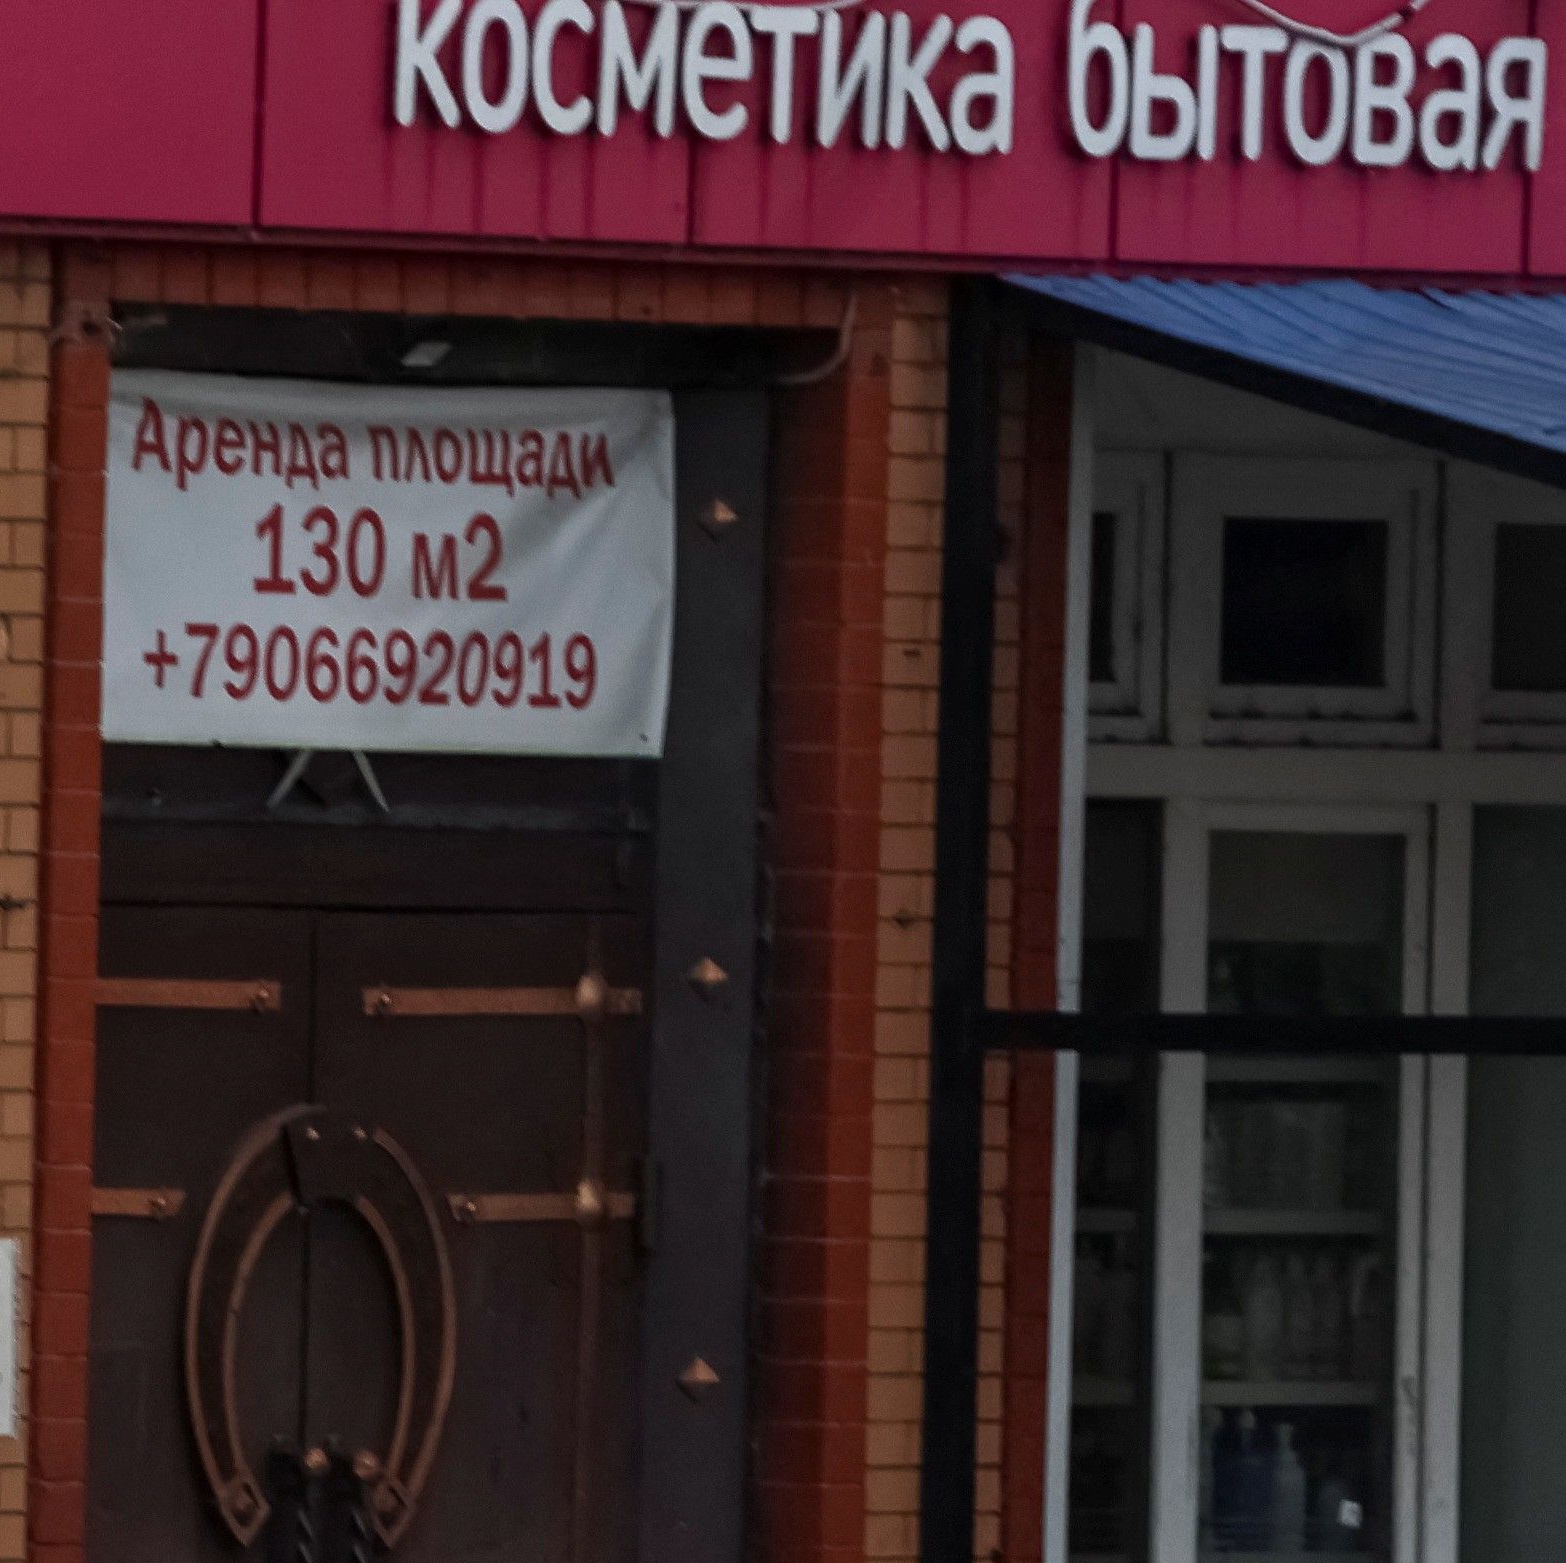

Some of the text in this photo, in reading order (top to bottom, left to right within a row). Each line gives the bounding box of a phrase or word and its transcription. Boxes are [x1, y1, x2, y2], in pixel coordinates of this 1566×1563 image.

[394, 0, 1547, 171] косметика бытовая
[132, 396, 615, 499] Аренда площади
[253, 503, 508, 601] 130 м2
[143, 622, 598, 710] +79066920919
